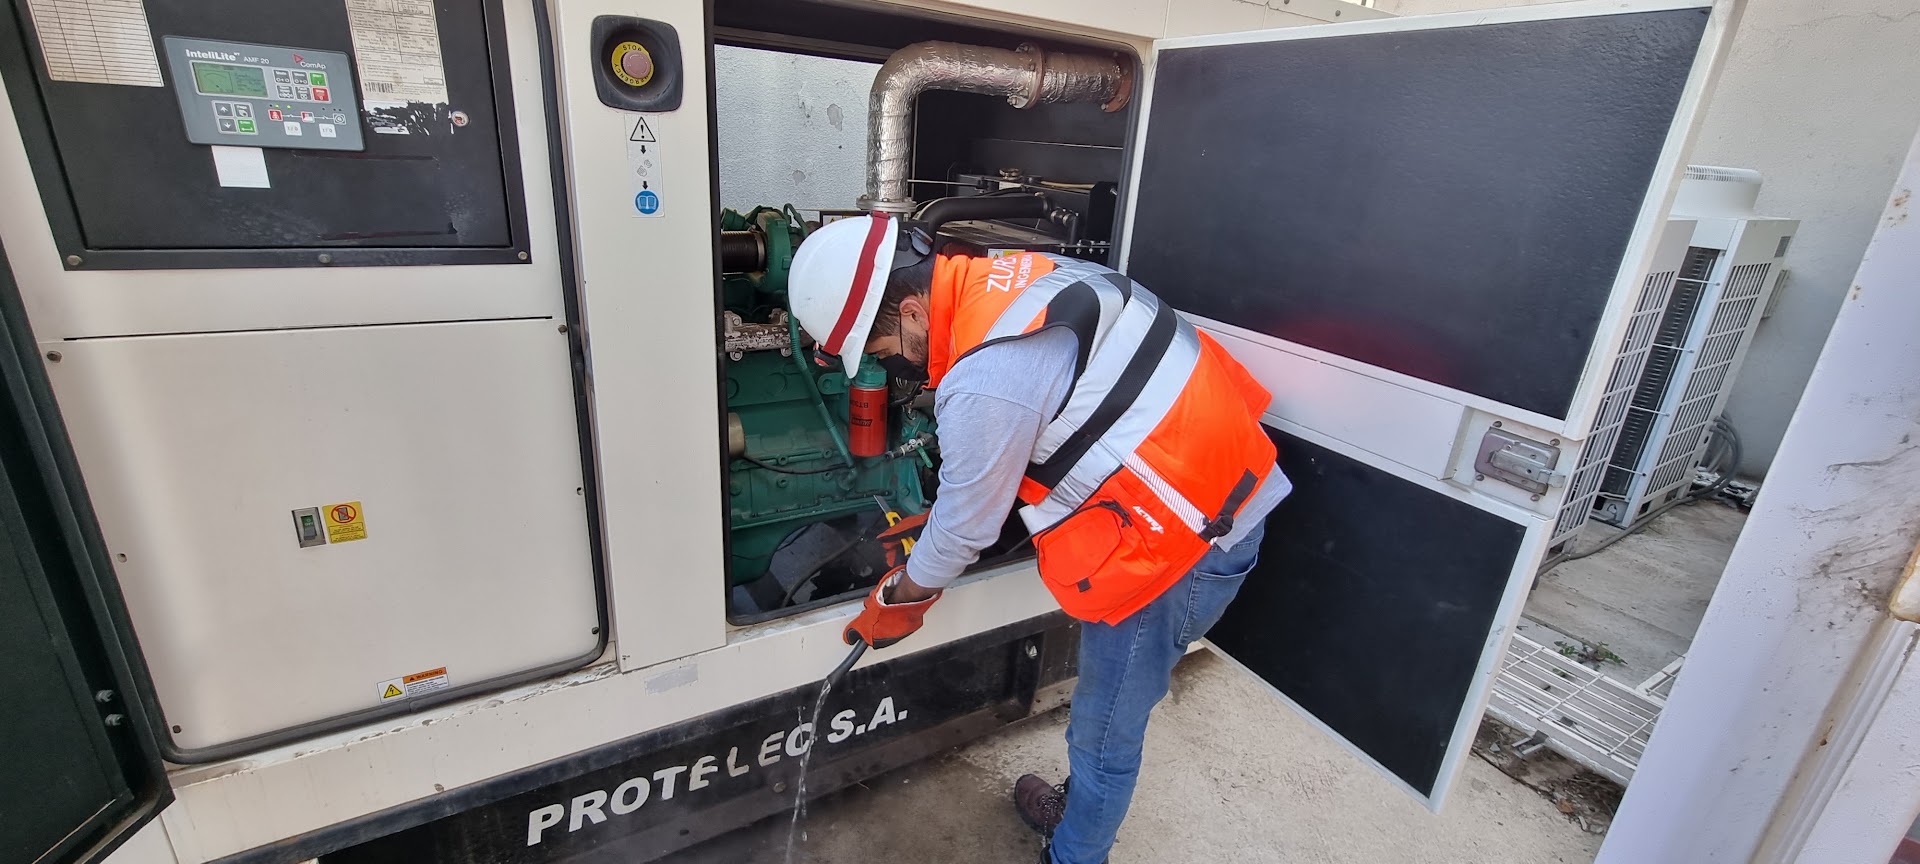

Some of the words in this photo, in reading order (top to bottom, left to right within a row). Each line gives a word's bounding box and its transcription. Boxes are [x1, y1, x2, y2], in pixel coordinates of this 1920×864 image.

[185, 49, 236, 61] InteliLite
[300, 61, 326, 70] ComAp
[527, 723, 815, 846] PROTELEC
[827, 696, 909, 744] S.A.
